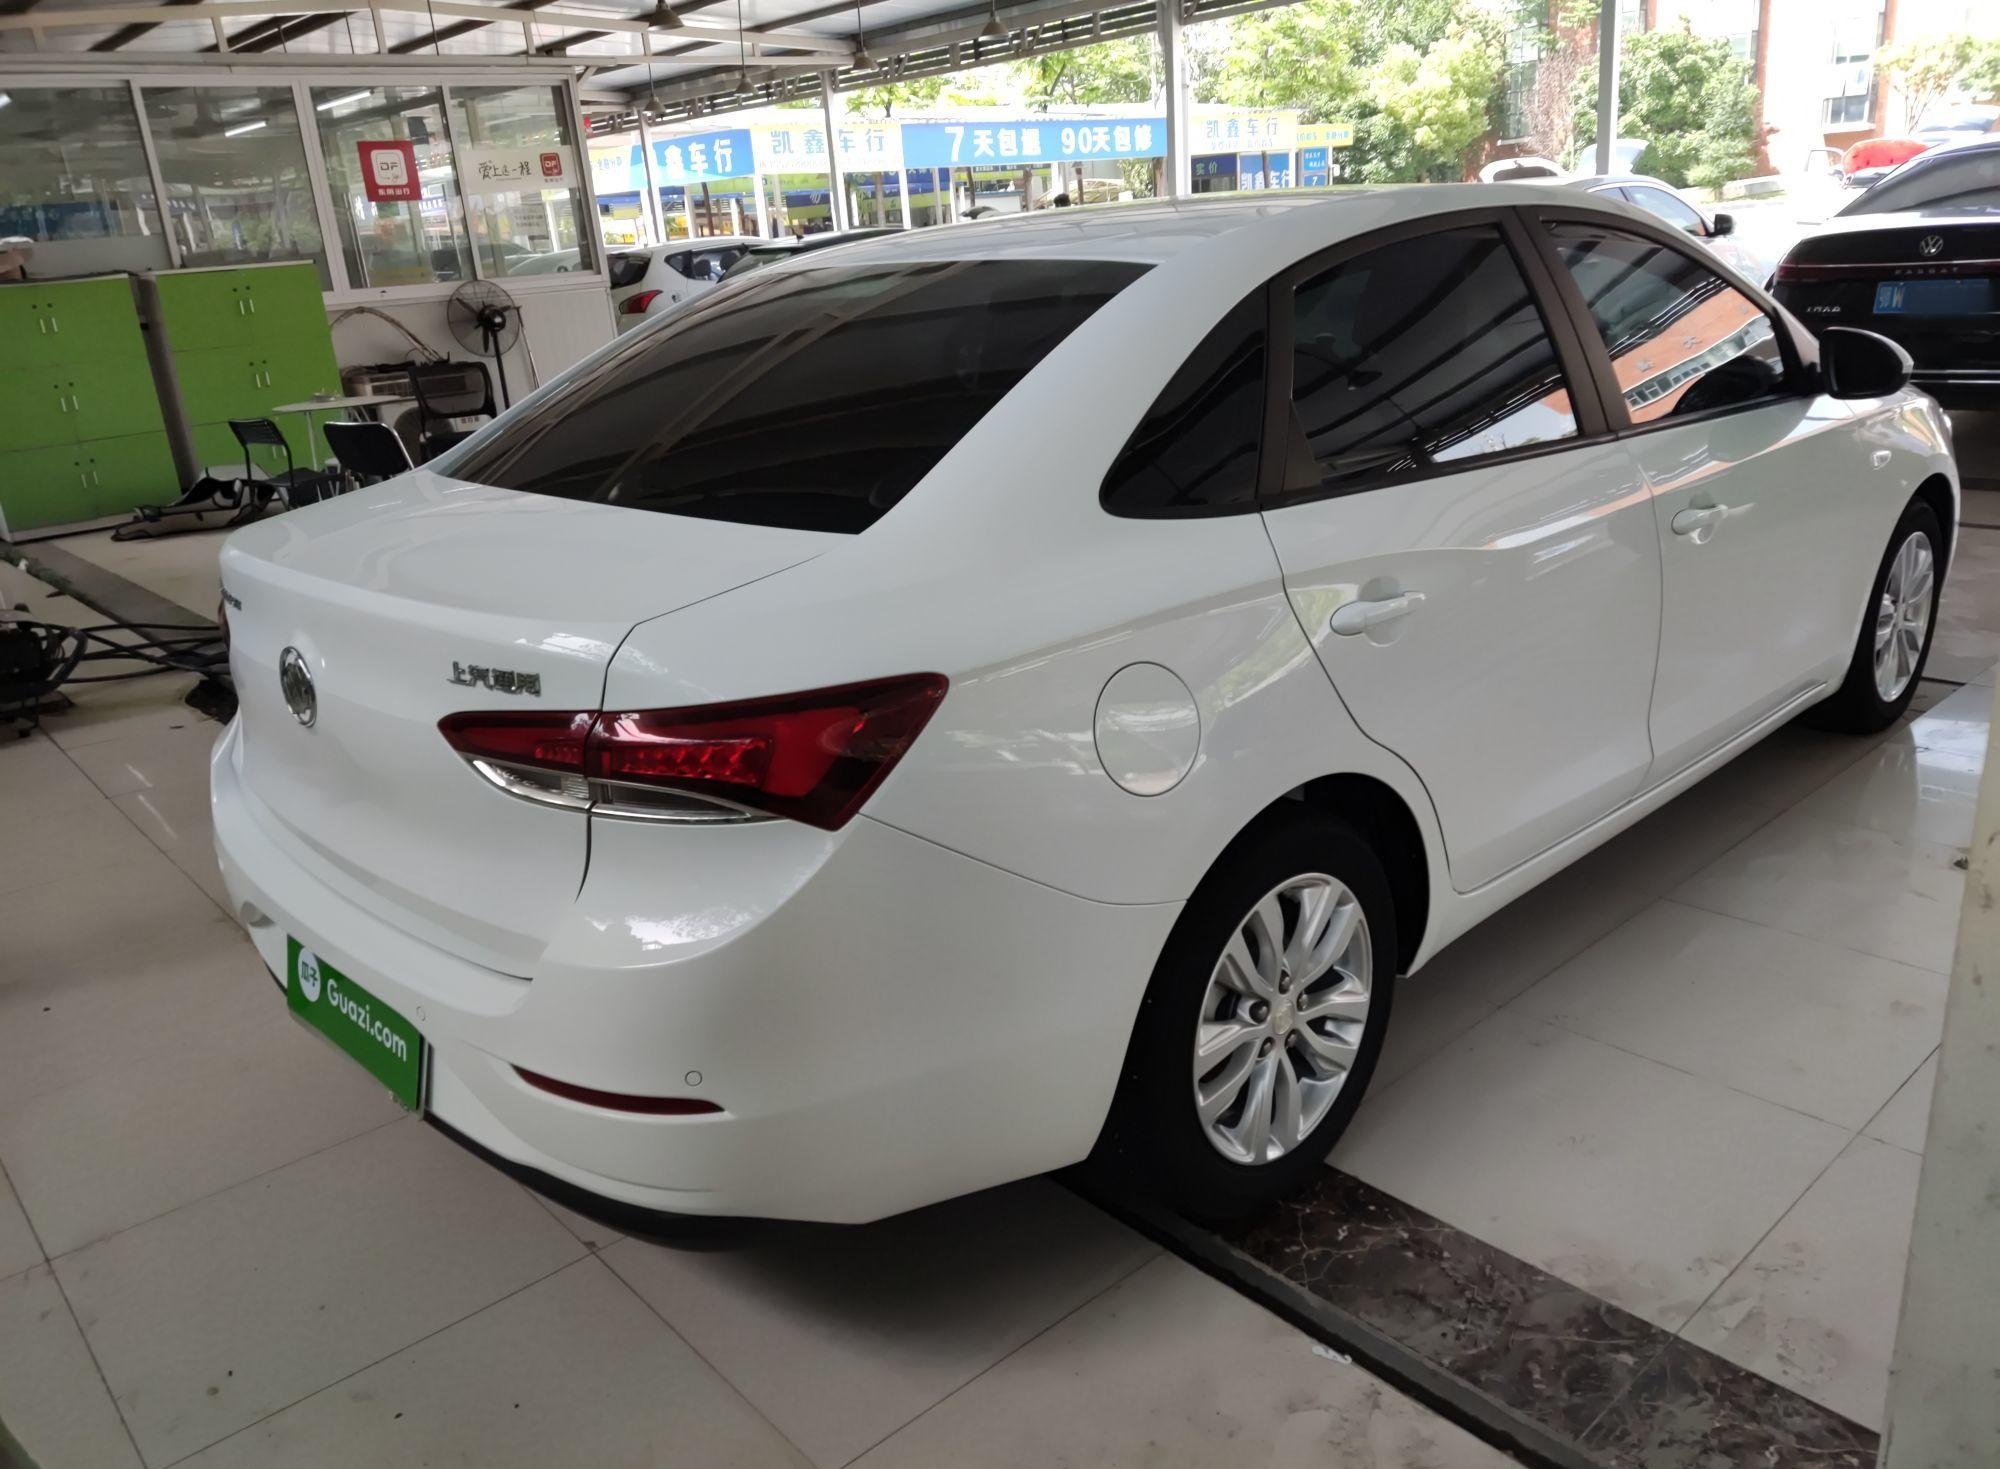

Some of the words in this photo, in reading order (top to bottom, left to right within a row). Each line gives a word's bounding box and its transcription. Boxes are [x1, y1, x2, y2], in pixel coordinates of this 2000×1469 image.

[1206, 117, 1279, 138] 凯鑫车行
[770, 128, 885, 155] 凯鑫车行
[478, 160, 532, 181] 爱上这一程
[301, 961, 318, 987] 瓜子
[327, 978, 407, 1062] Guazi.com
